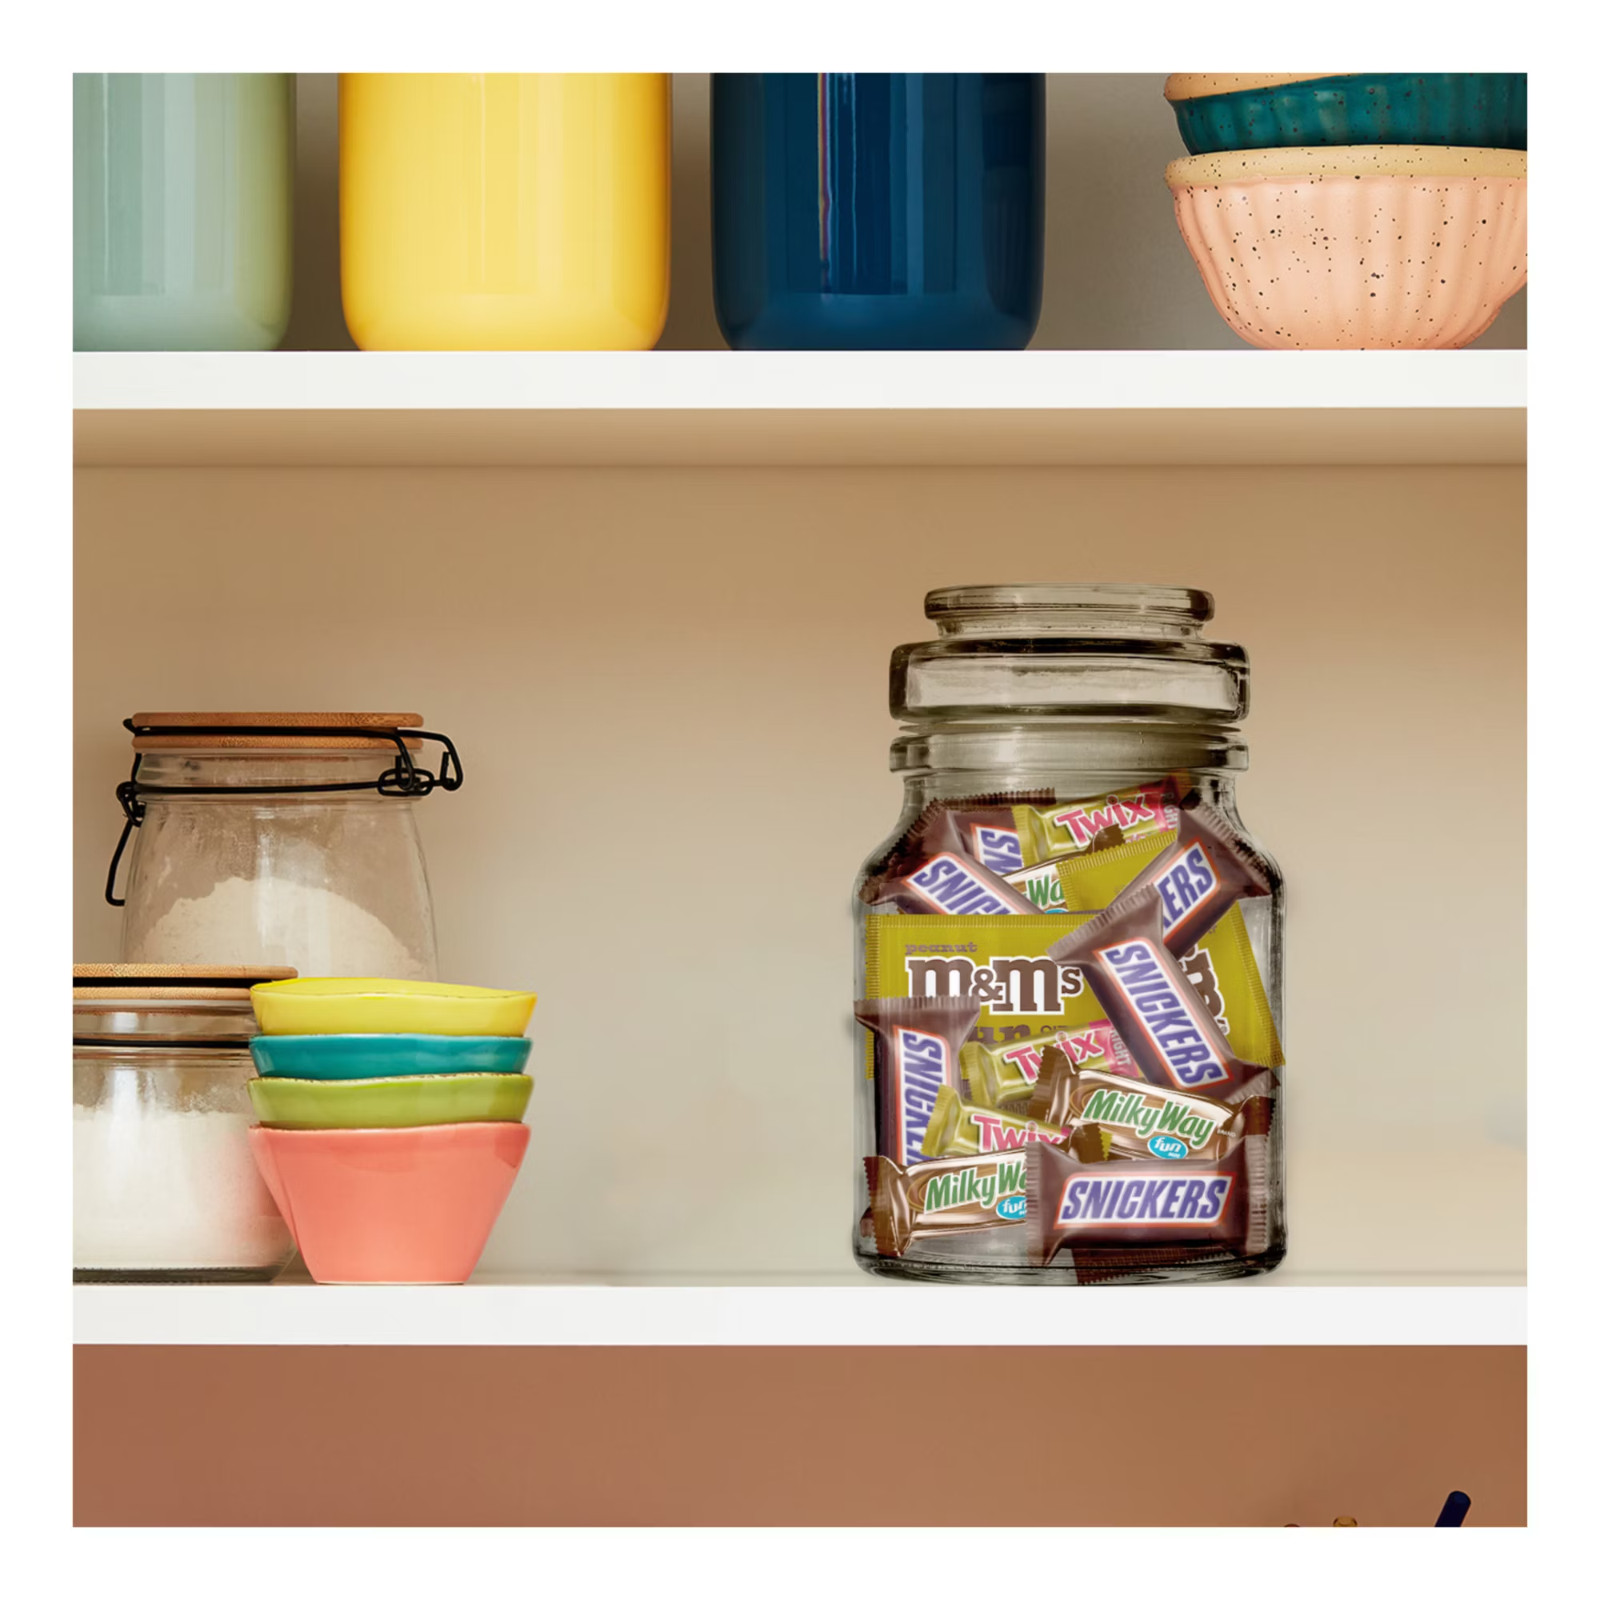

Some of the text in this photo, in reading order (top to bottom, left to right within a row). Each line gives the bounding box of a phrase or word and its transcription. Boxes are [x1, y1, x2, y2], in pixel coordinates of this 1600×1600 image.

[1055, 795, 1154, 847] Twix
[904, 942, 978, 956] peanut
[1105, 944, 1224, 1084] SNICKERS
[1082, 1090, 1216, 1147] Milky Way
[1154, 1136, 1182, 1153] fun
[925, 1168, 997, 1212] Milky
[1061, 1179, 1228, 1220] SNICKERS
